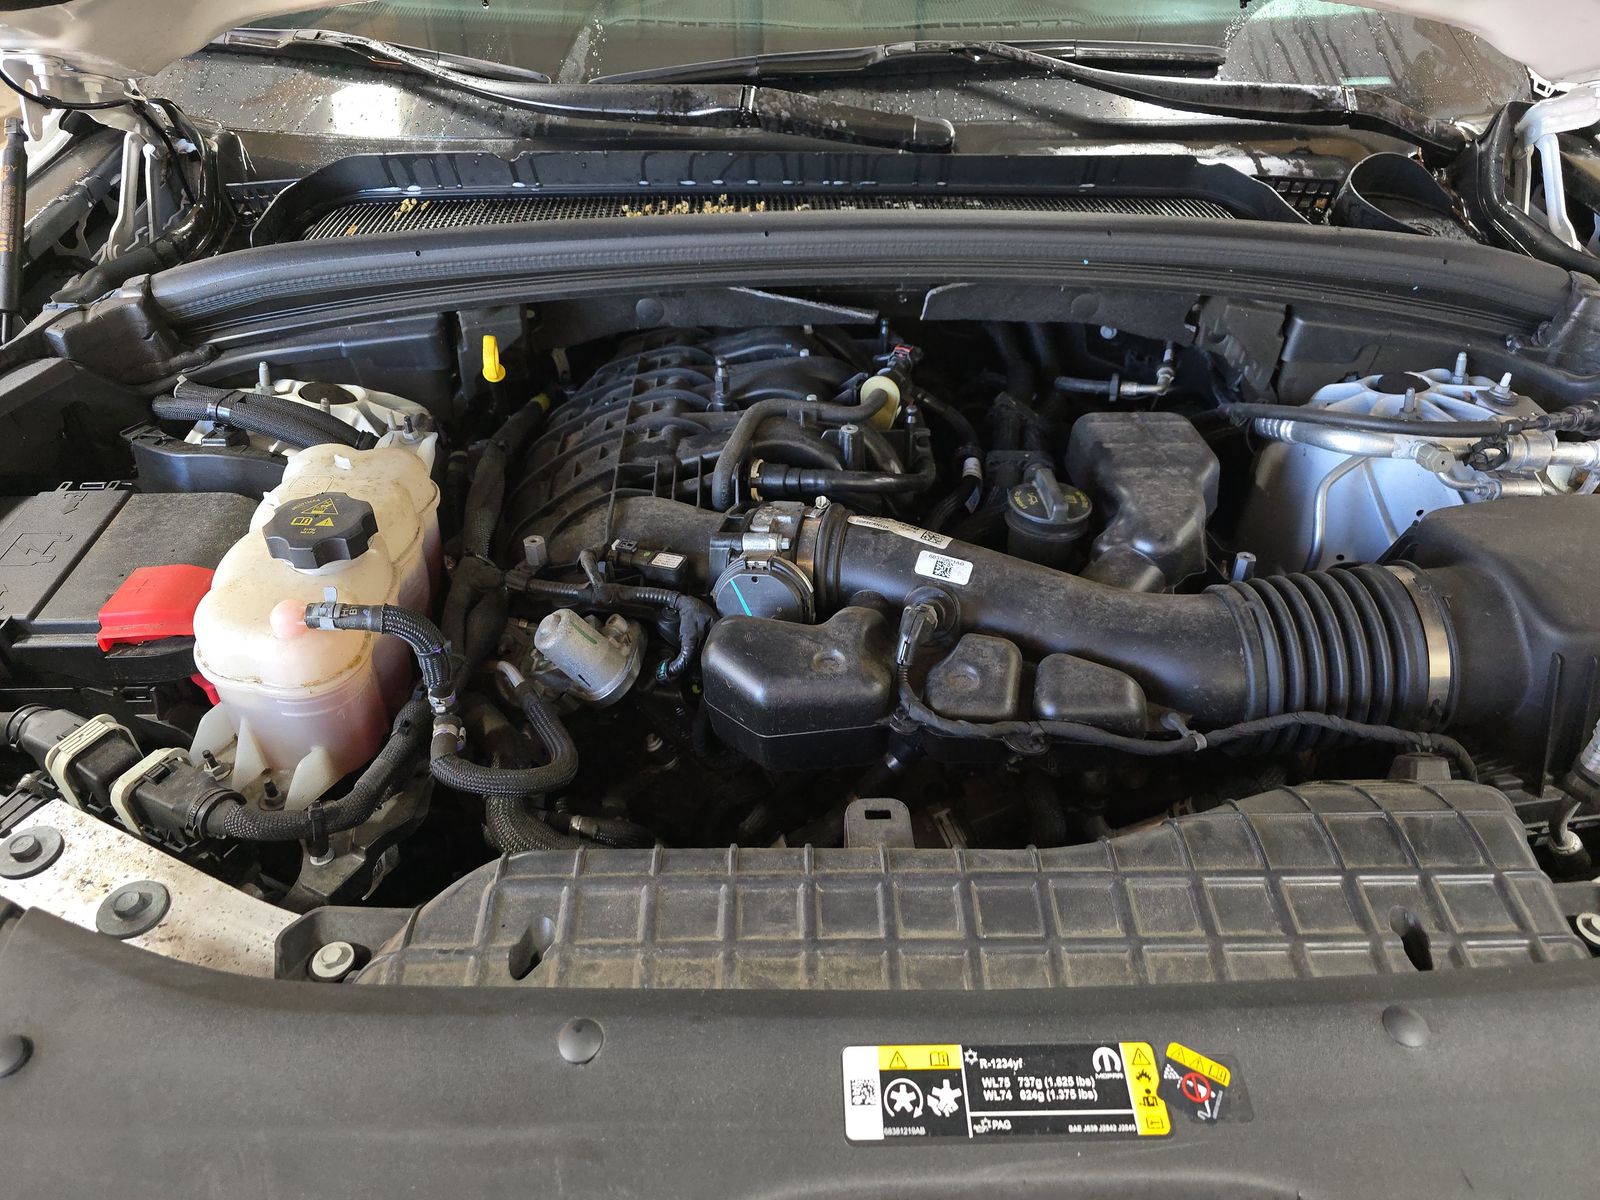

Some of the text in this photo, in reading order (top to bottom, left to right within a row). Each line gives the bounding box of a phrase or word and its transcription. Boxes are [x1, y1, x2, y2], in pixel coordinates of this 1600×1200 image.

[979, 1058, 1023, 1073] R-1234yf
[981, 1075, 1096, 1090] WL75 737g (1.625 lbs)
[983, 1088, 1098, 1102] WL74 624g (1.375 lbs)
[992, 1119, 1012, 1130] PAG
